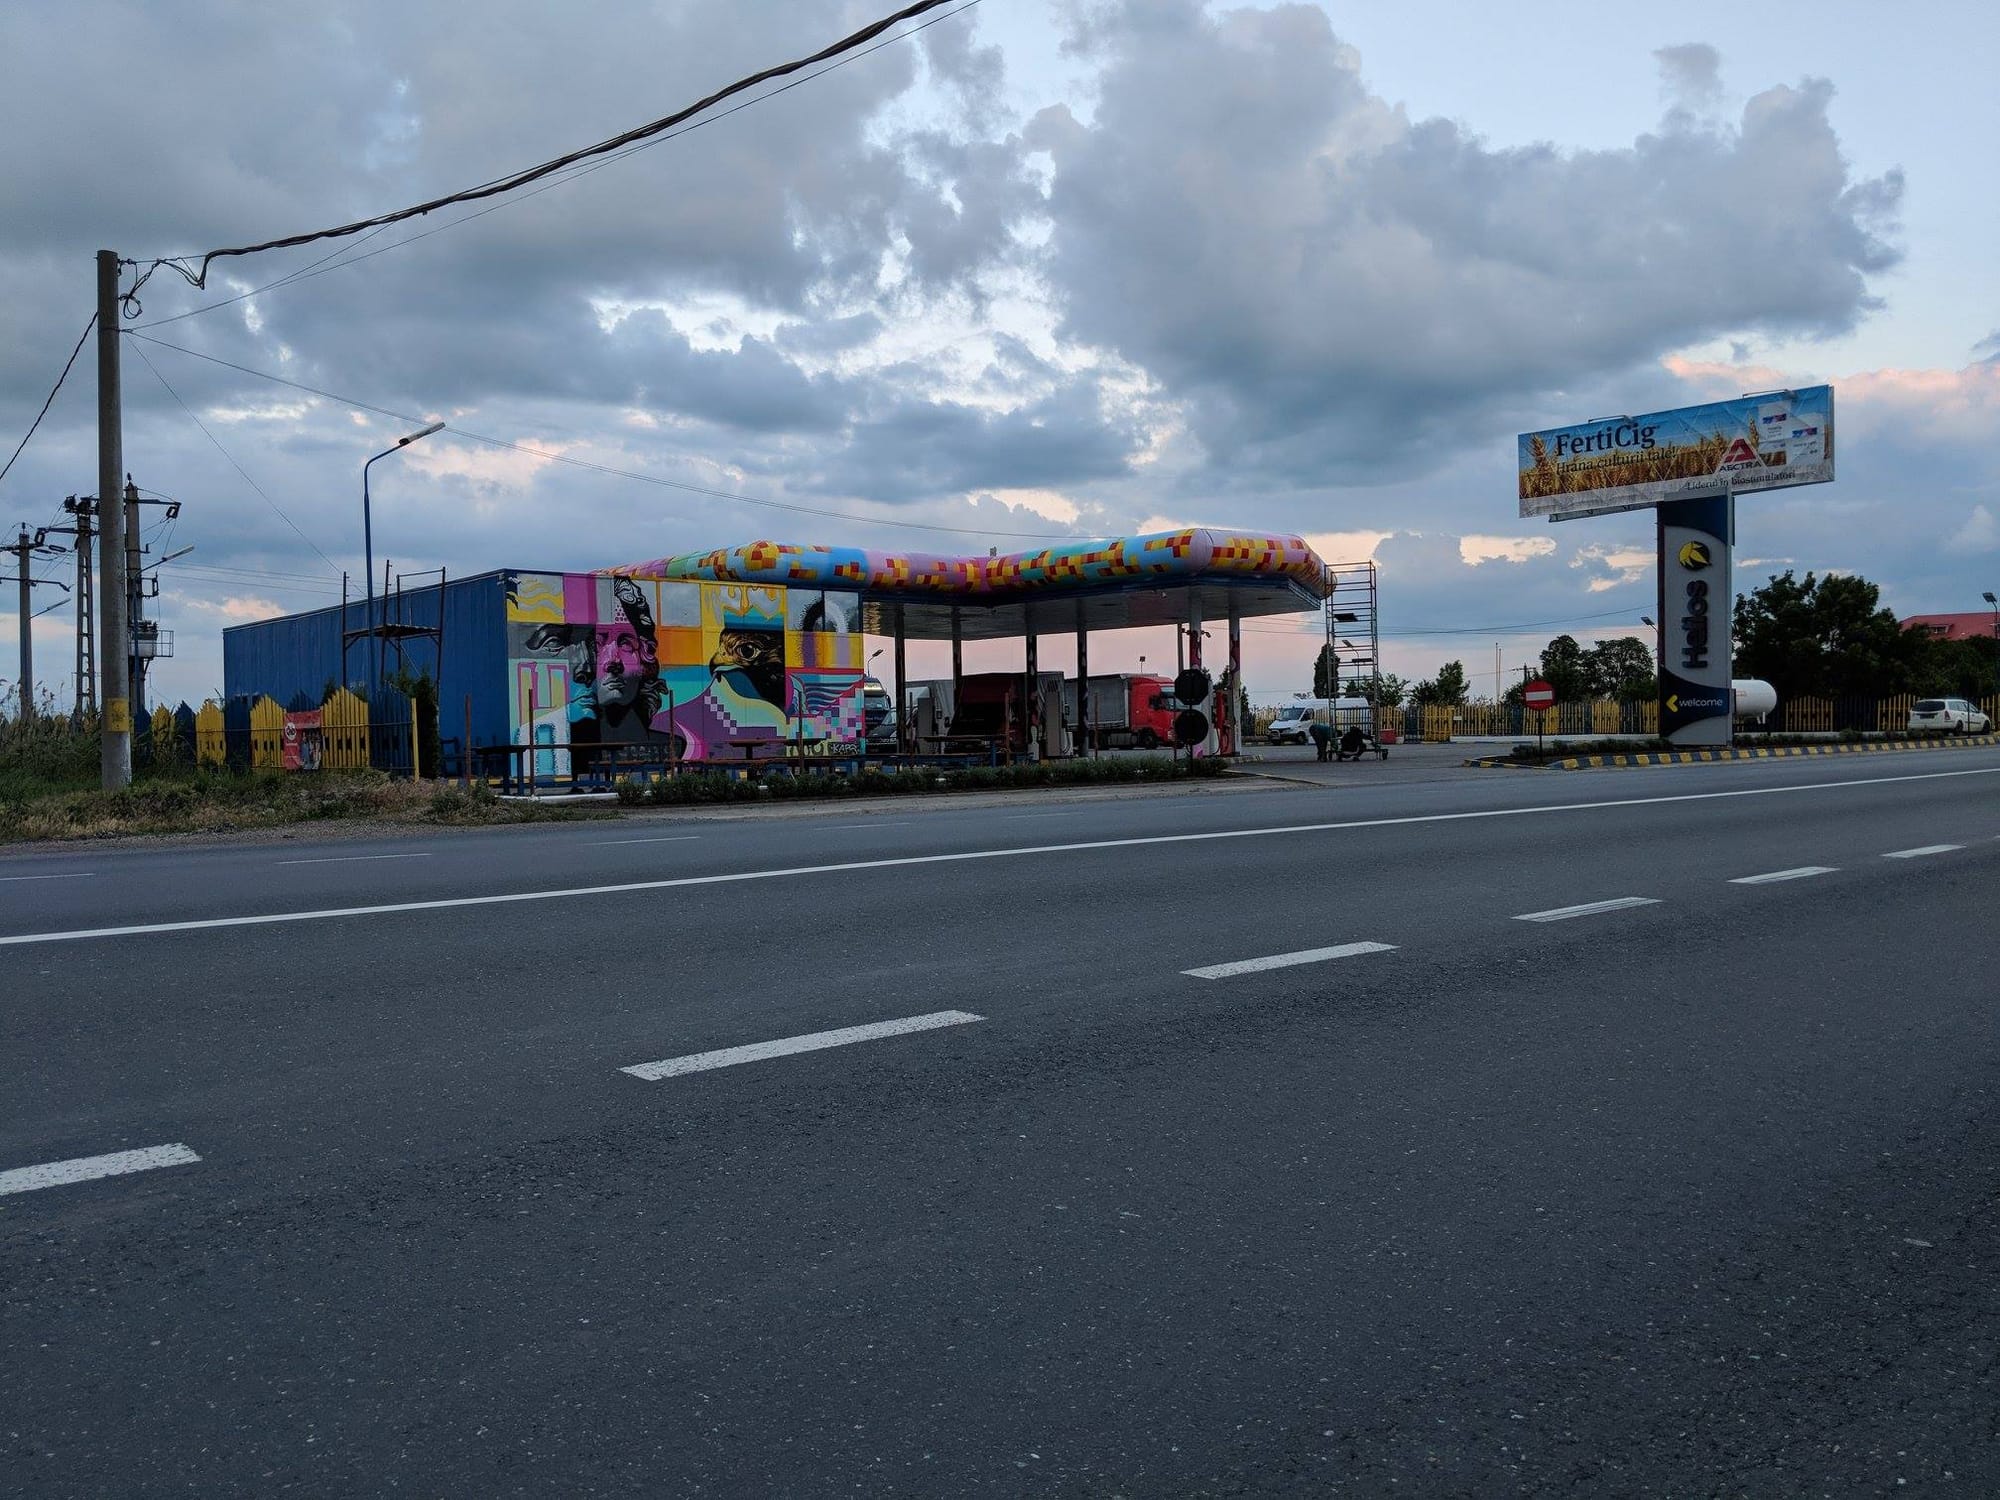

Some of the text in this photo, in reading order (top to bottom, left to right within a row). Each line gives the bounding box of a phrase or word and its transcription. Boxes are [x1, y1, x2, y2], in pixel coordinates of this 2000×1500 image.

[1555, 423, 1657, 456] FertiCig
[1556, 461, 1593, 474] Hrana
[1679, 697, 1723, 707] welcome
